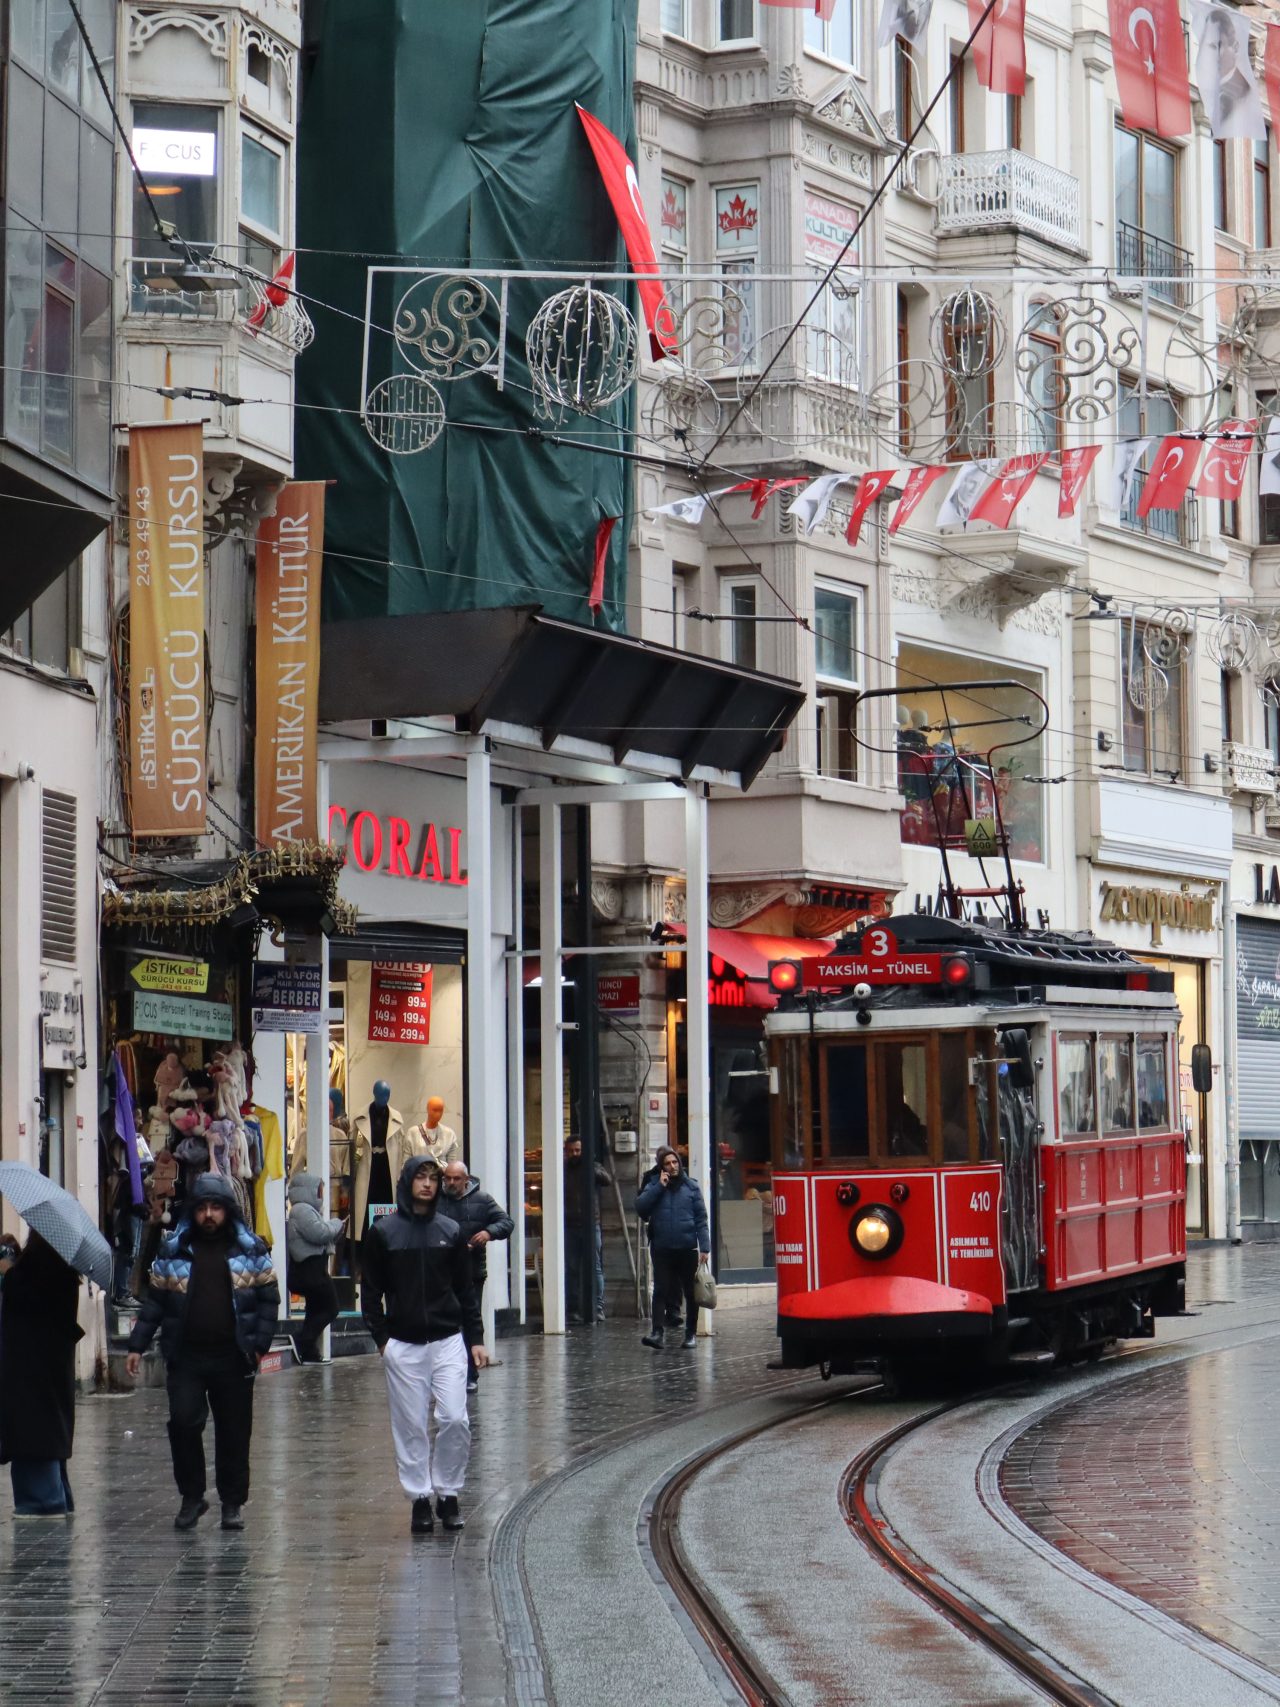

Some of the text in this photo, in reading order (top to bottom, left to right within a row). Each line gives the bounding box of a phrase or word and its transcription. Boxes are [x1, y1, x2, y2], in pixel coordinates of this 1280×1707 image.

[139, 142, 202, 161] FCUS
[136, 485, 150, 587] 243 49 43
[163, 453, 202, 812] SÜRÜCÜ KURSU
[271, 511, 309, 850] AMERİKAN KÜLTÜR
[328, 803, 469, 887] CORAL
[973, 841, 991, 850] 600
[870, 930, 889, 957] 3
[817, 962, 933, 977] TAKSİM TÜNEL
[176, 977, 205, 987] KURSU
[272, 989, 320, 1007] BERBER
[189, 1004, 211, 1021] Training
[969, 1190, 991, 1212] 410
[950, 1248, 959, 1259] VE
